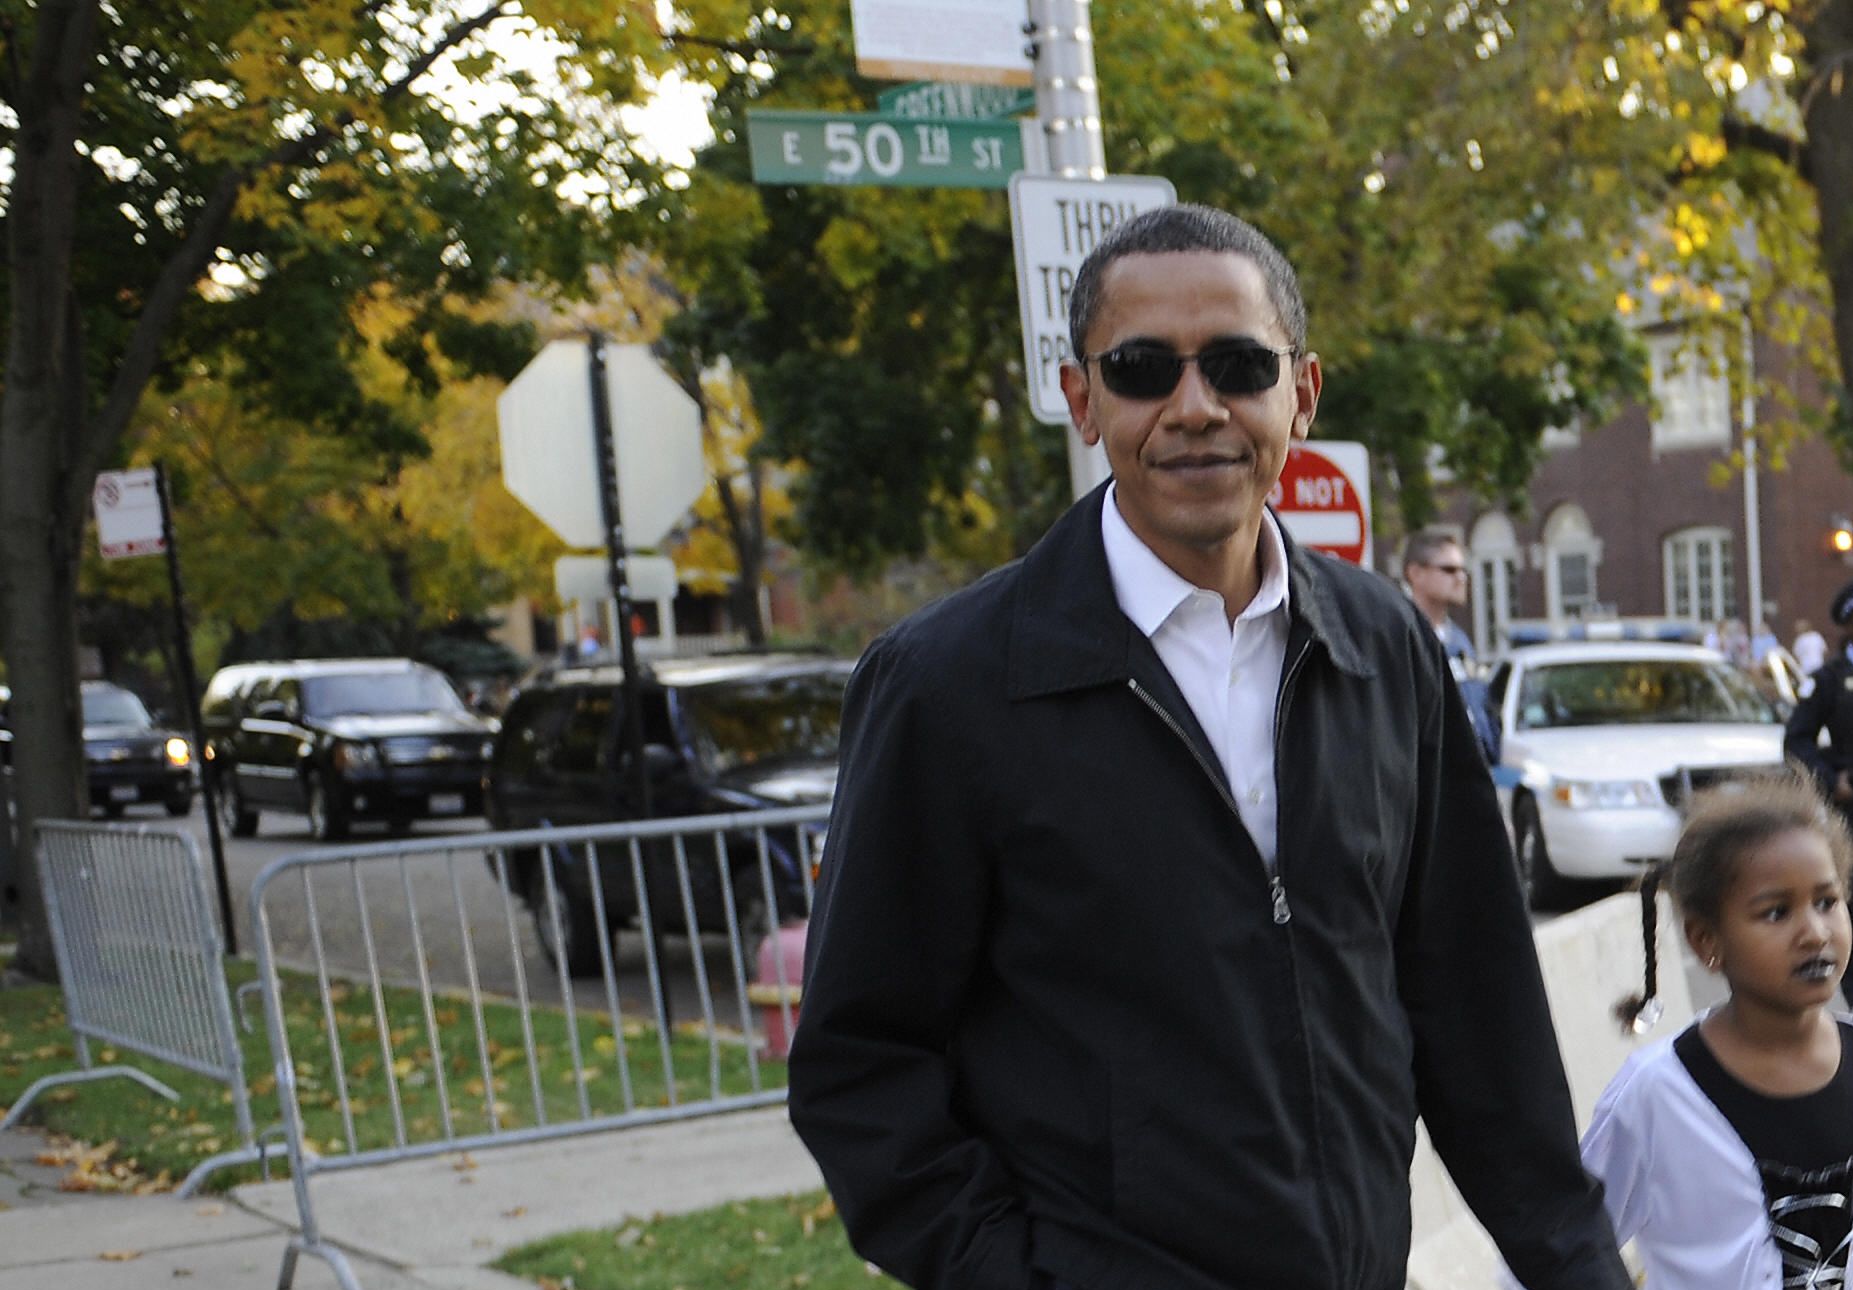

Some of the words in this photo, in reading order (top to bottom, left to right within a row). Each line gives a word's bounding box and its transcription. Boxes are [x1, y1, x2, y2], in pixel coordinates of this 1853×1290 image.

[783, 131, 802, 164] E
[972, 137, 1003, 170] ST
[1295, 477, 1344, 506] NOT
